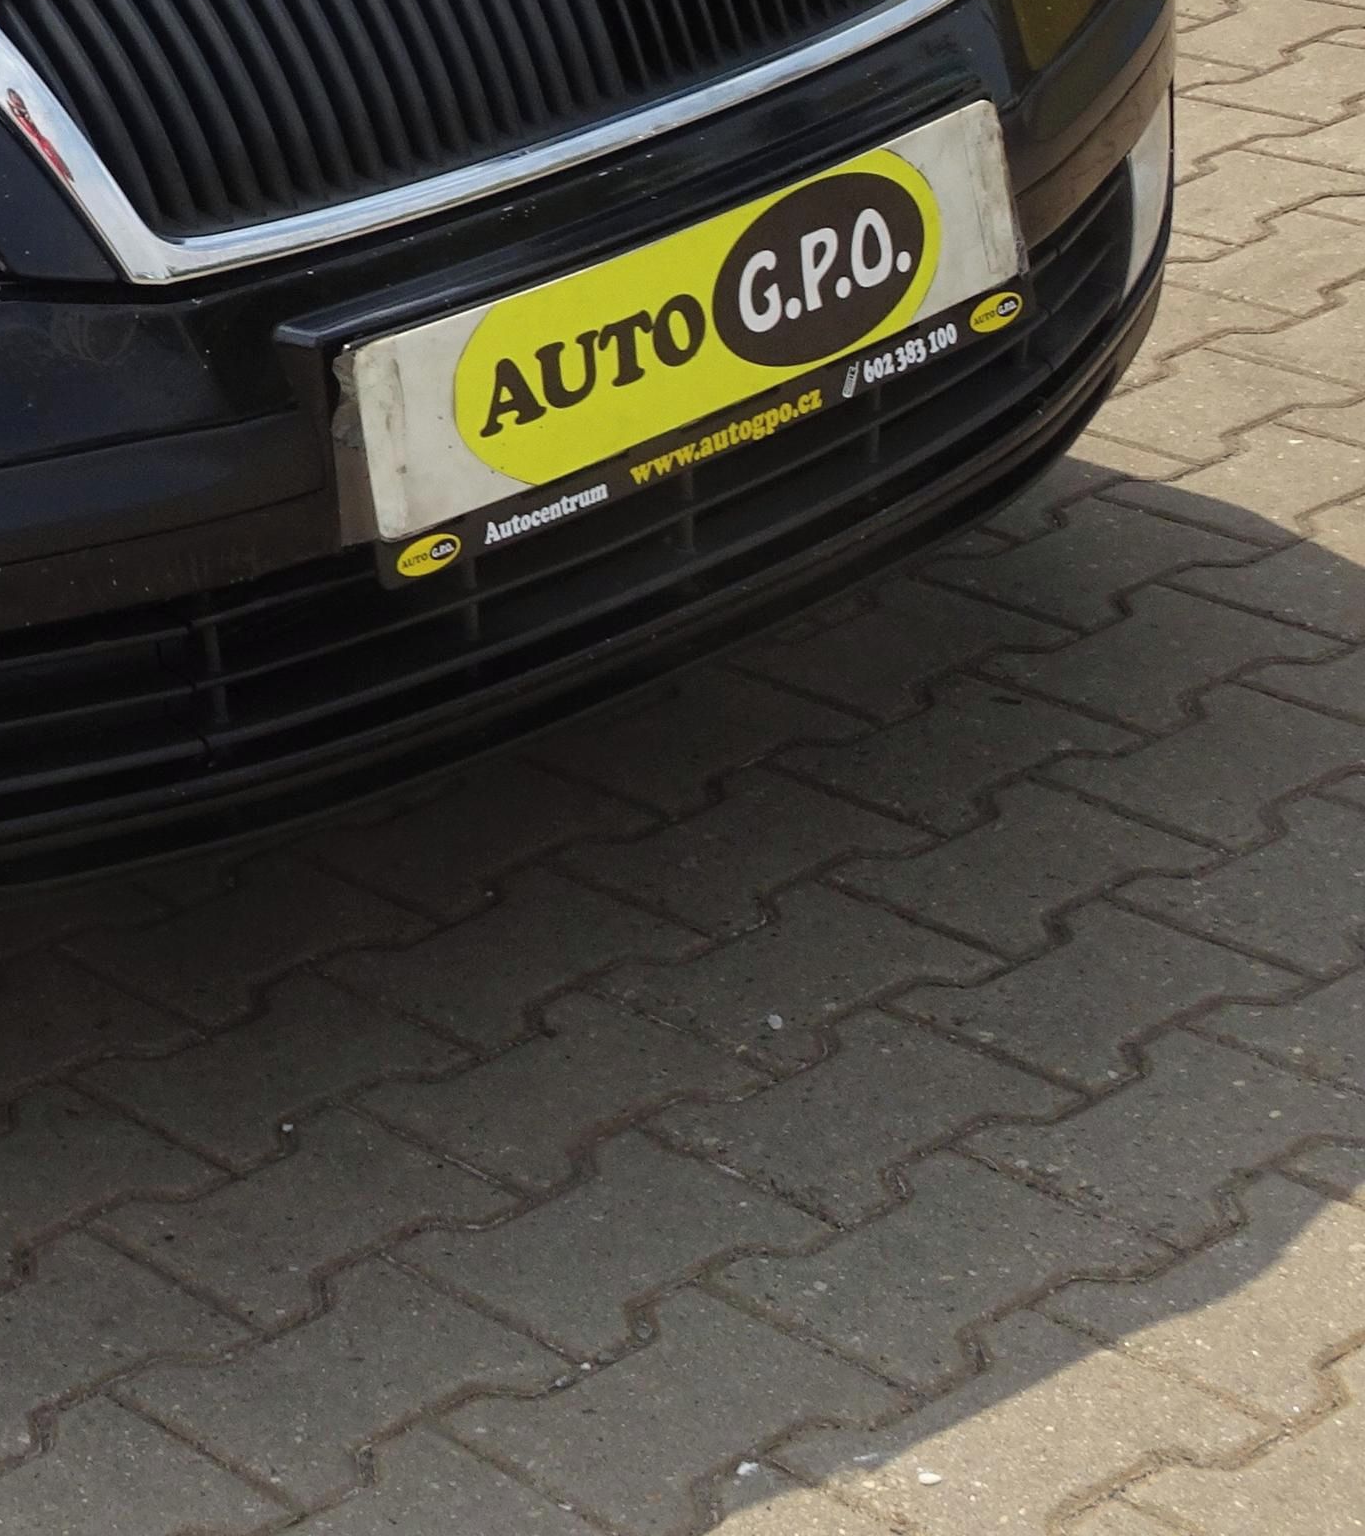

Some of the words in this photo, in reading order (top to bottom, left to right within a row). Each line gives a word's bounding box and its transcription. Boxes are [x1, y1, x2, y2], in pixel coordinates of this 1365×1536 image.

[479, 293, 706, 438] AUTO
[737, 207, 913, 333] G.P.O.
[484, 483, 609, 545] Autocentrum
[629, 388, 824, 485] www.autogpo.cz
[863, 352, 896, 384] 602
[895, 337, 927, 373] 383
[927, 322, 959, 354] 100
